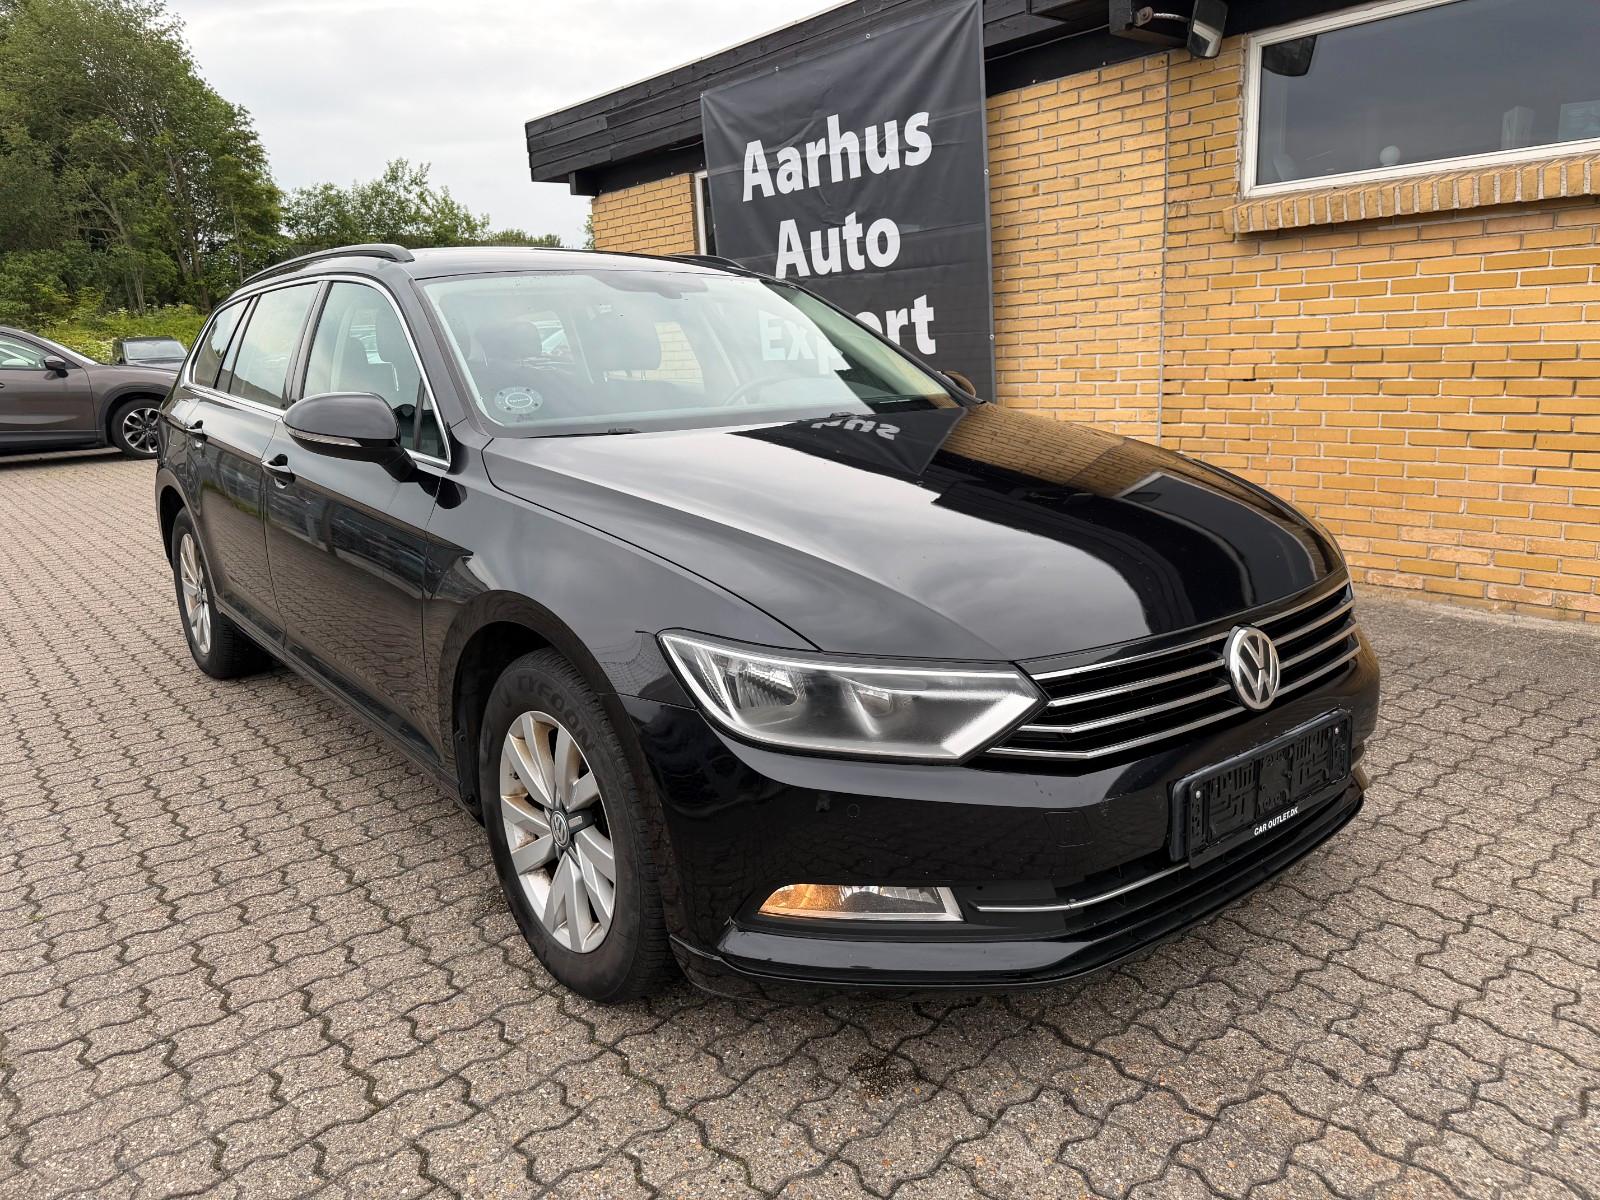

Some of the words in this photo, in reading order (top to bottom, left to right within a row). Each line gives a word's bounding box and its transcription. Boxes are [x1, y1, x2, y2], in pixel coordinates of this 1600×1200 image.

[743, 111, 932, 202] Aarhus
[776, 211, 901, 279] Auto
[1234, 629, 1280, 708] VW
[1254, 823, 1267, 836] CAR
[1268, 806, 1298, 829] OUTLET.DK
